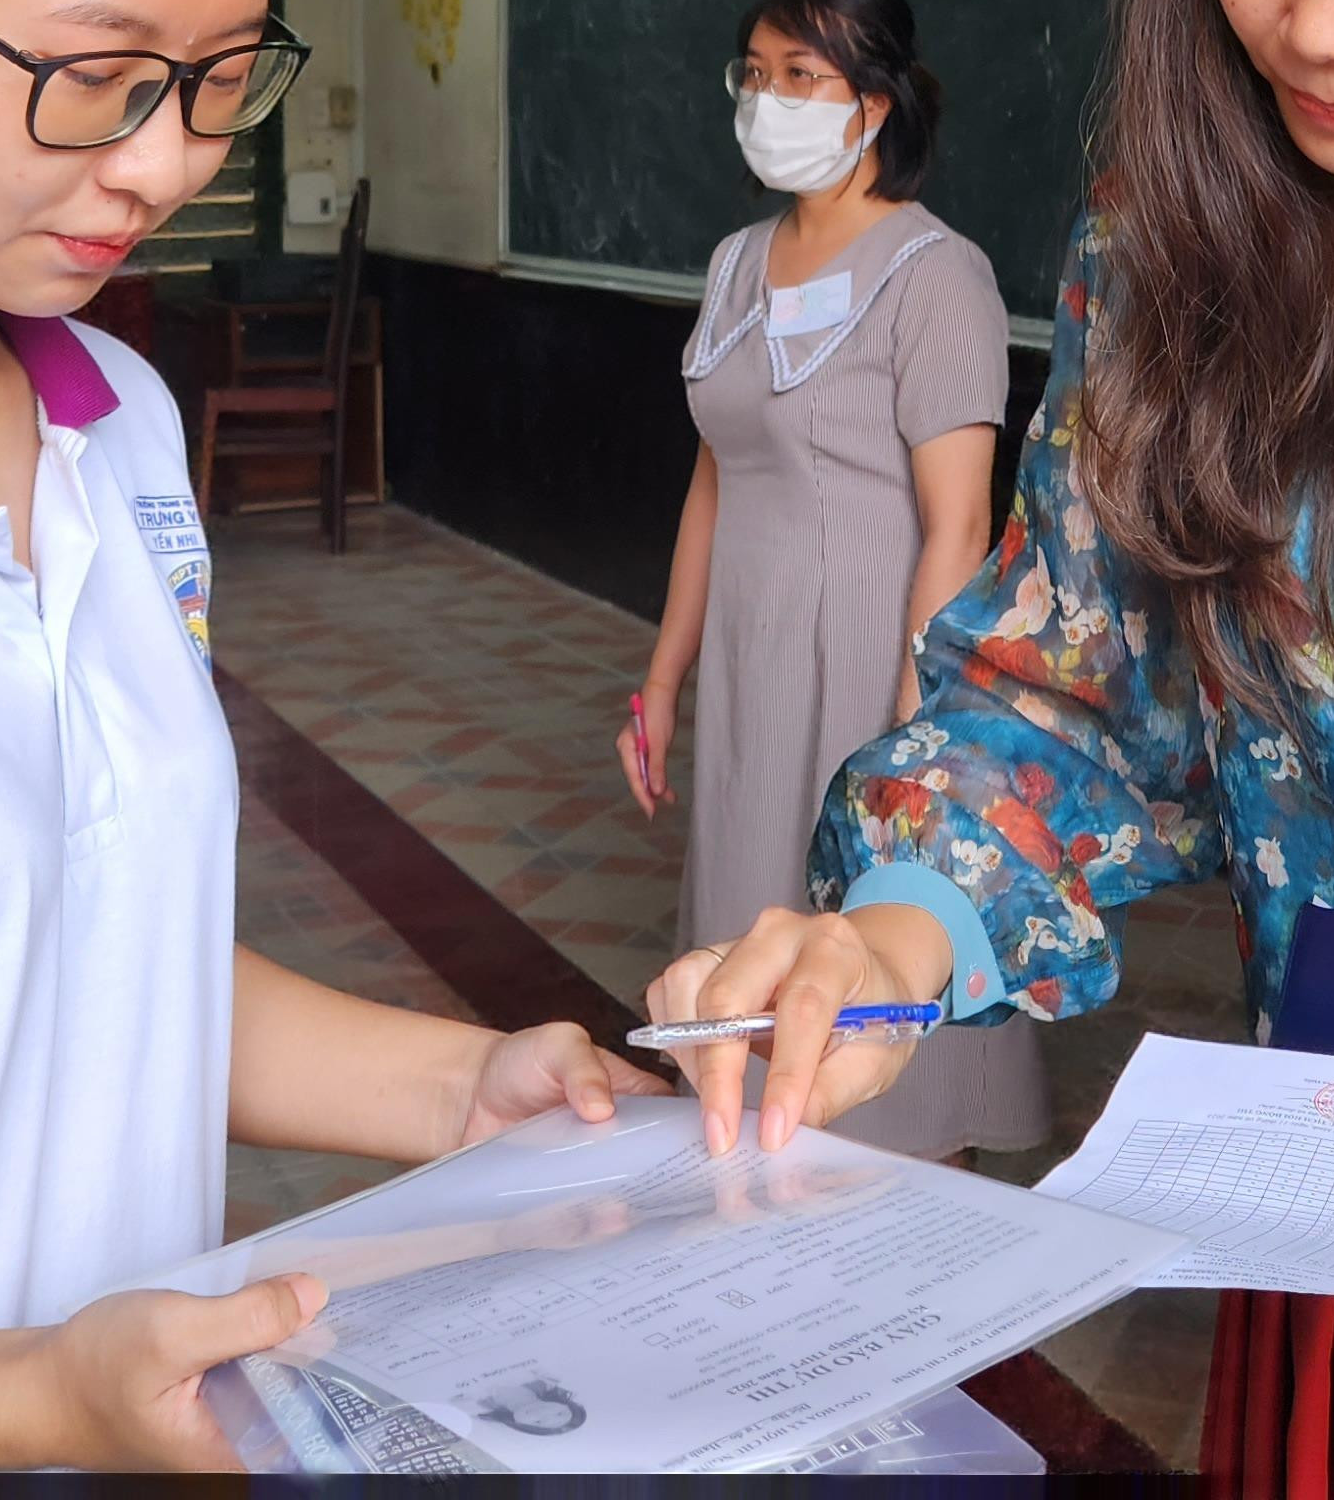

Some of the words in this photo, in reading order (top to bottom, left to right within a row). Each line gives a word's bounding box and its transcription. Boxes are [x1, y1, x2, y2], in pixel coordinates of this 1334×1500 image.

[886, 1315, 941, 1343] GIẤY
[833, 1341, 883, 1366] BÁO
[795, 1364, 832, 1386] DỰ
[746, 1381, 795, 1402] THI
